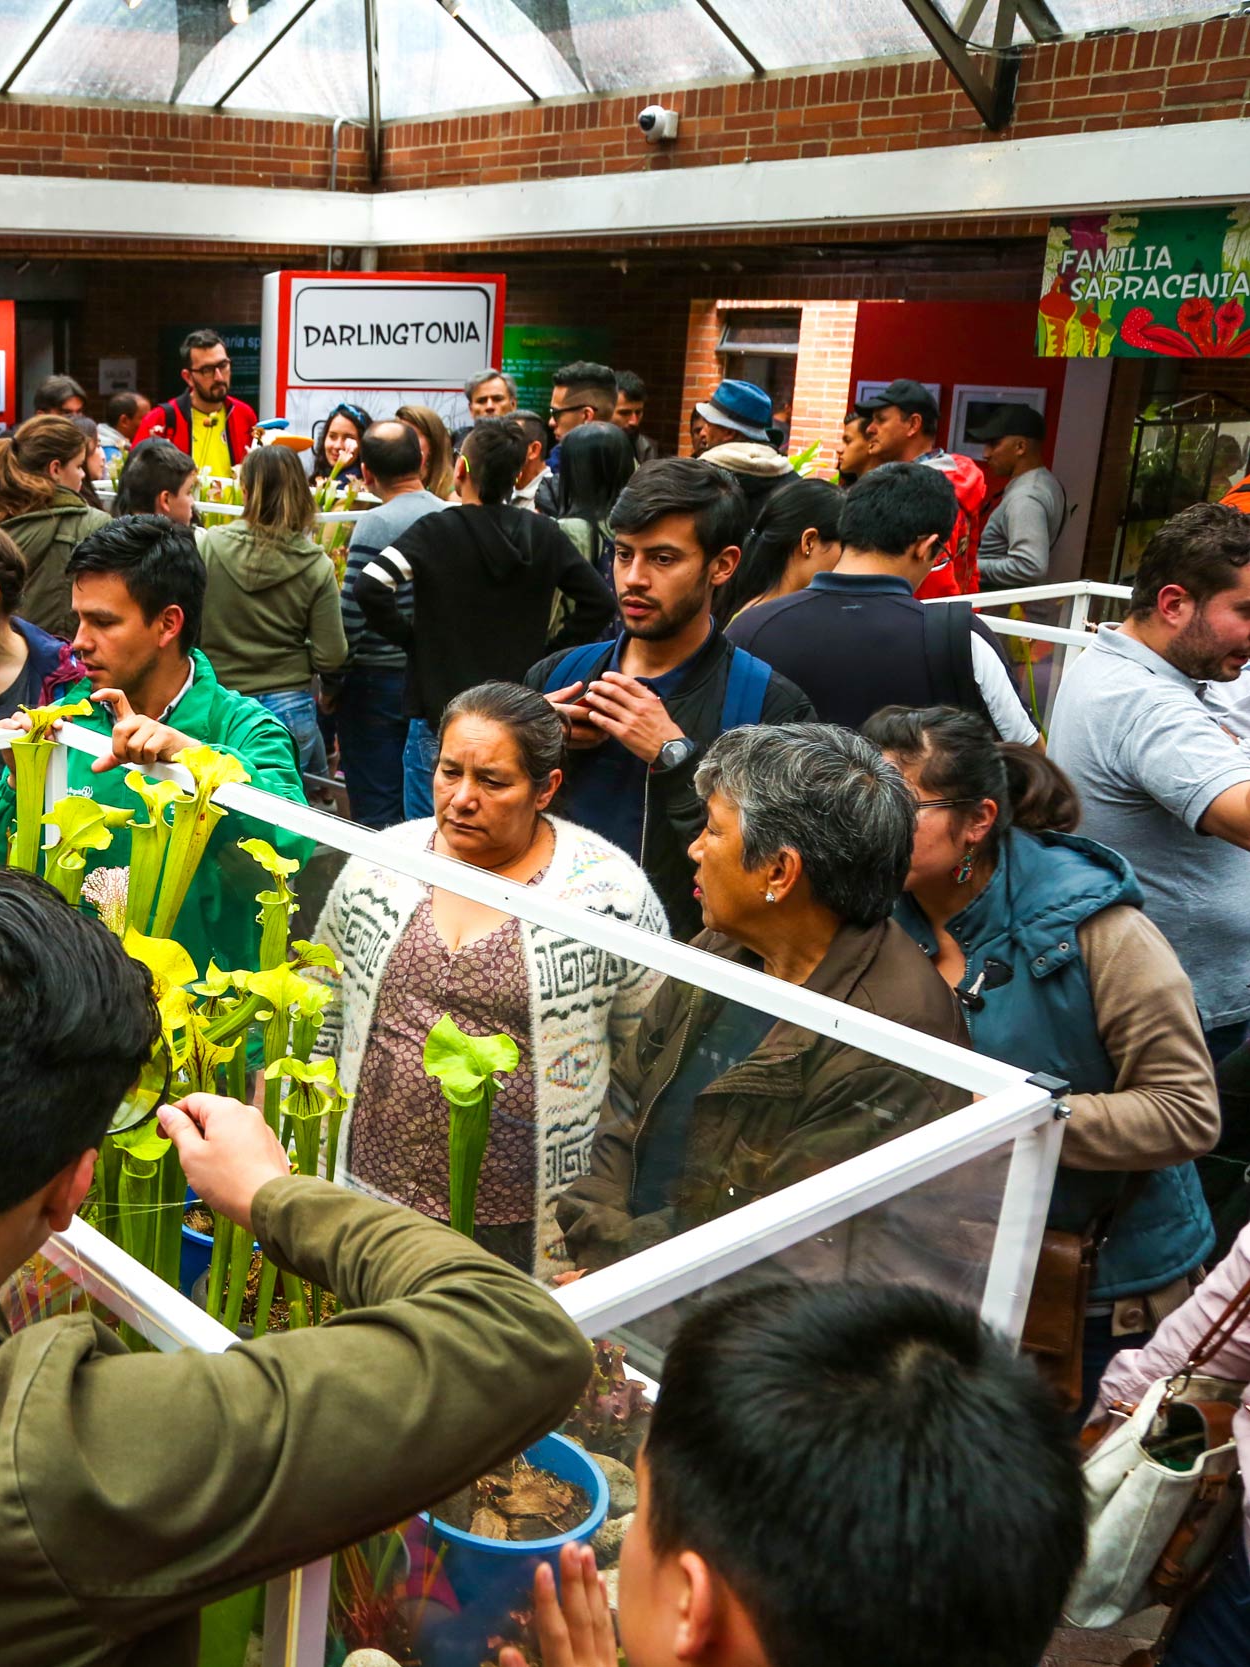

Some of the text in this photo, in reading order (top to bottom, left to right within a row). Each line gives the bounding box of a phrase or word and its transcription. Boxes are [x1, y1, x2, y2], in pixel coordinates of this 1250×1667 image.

[1060, 245, 1172, 274] FAMILIA
[1070, 272, 1250, 301] SARRACENIA
[303, 321, 481, 348] DARLINGTONIA
